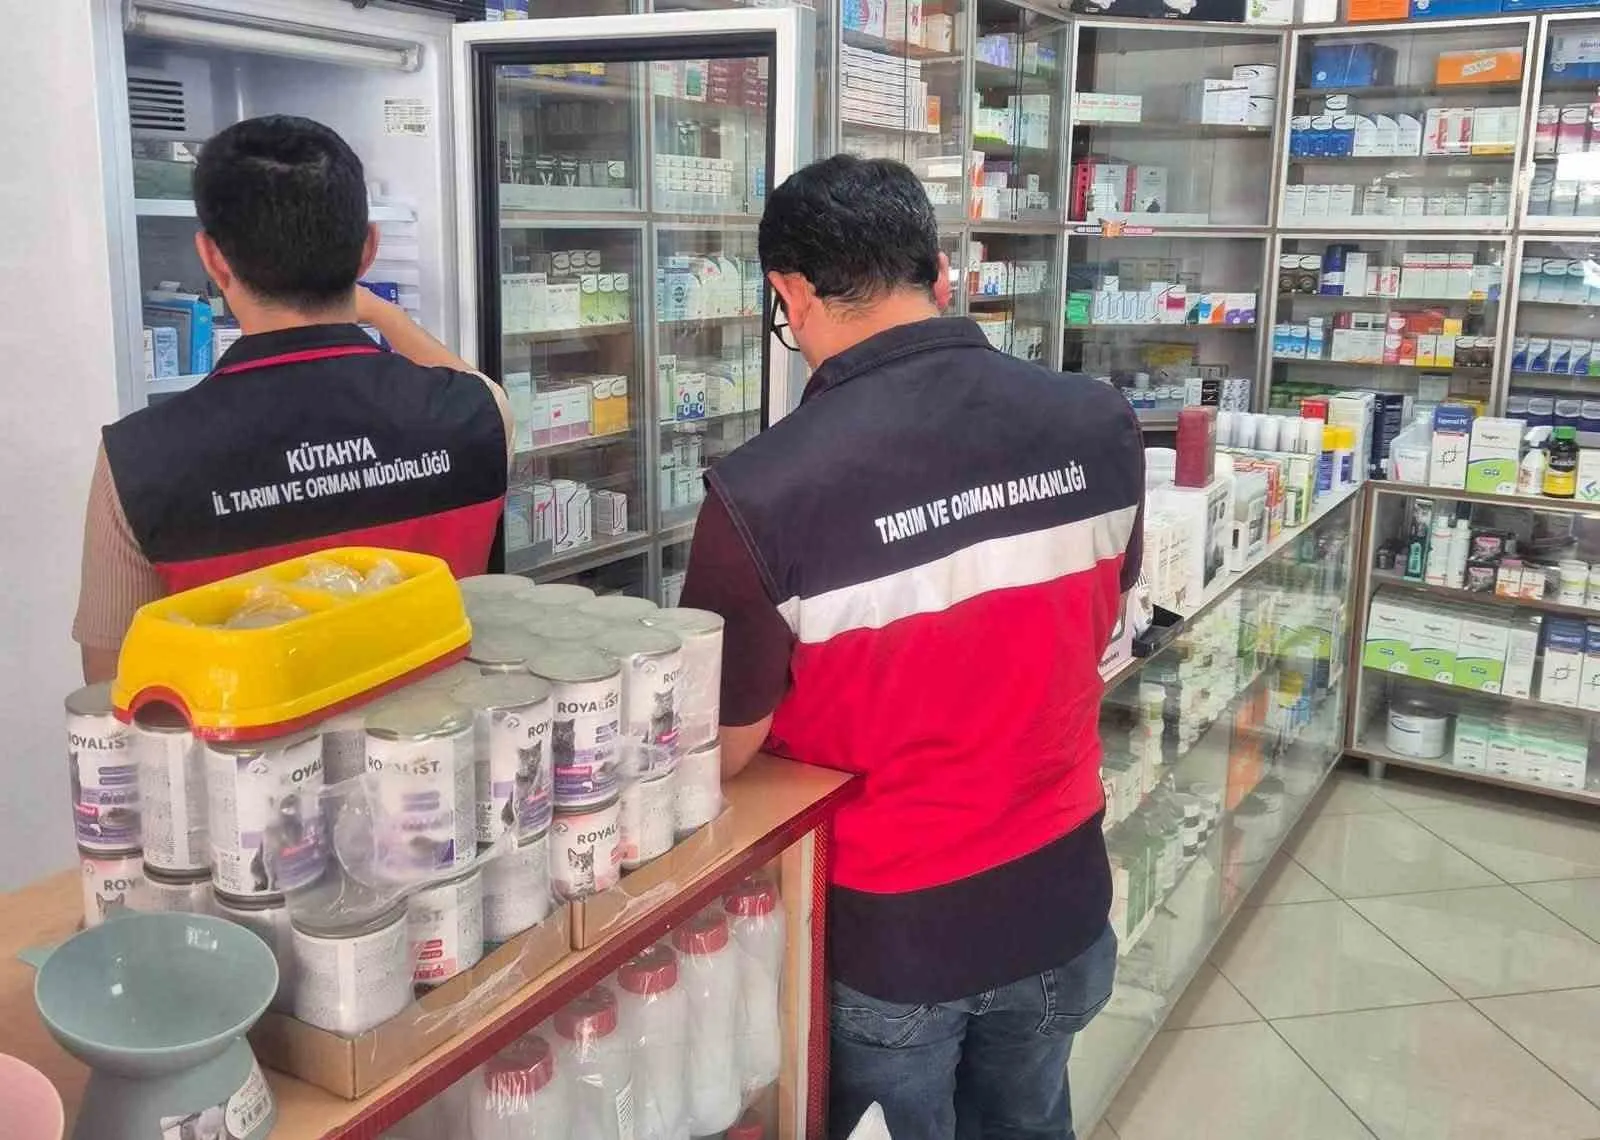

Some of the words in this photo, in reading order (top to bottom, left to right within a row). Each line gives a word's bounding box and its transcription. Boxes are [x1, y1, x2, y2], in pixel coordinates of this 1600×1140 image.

[212, 491, 230, 516] İL
[230, 484, 280, 513] TARIM
[281, 481, 304, 503] VE
[308, 473, 361, 498] ORMAN
[364, 449, 450, 489] MÜDÜRLÜĞÜ
[286, 436, 376, 474] KÜTAHYA
[875, 503, 927, 544] TARIM
[929, 498, 950, 529] VE
[951, 482, 1005, 520] ORMAN
[1008, 460, 1086, 506] BAKANLIĞI
